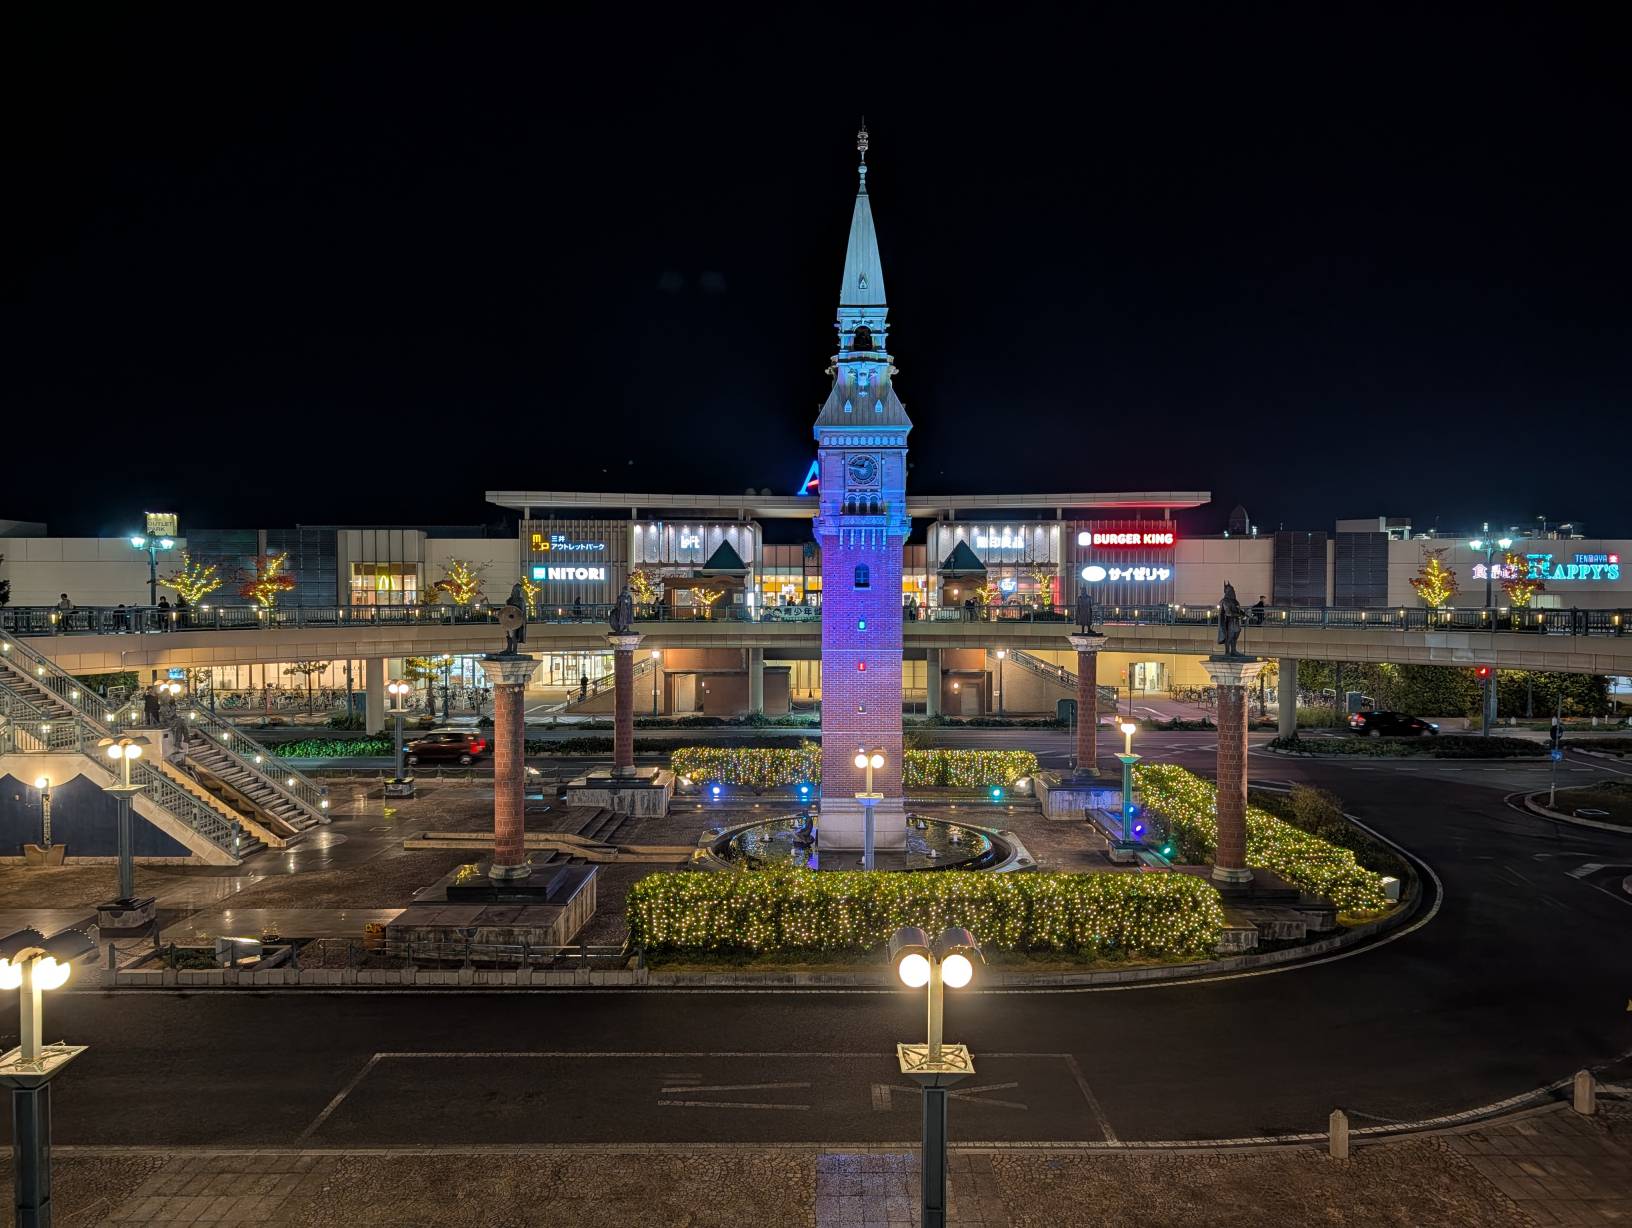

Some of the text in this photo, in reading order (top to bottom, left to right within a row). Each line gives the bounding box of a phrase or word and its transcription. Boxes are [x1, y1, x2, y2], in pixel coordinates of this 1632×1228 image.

[551, 535, 566, 543] 三井
[1093, 533, 1142, 545] BURGER
[1143, 533, 1174, 545] KING
[551, 543, 605, 551] アウトレットパーク
[1526, 554, 1620, 580] HAPPY'S
[548, 567, 605, 580] NITORI
[1108, 567, 1170, 581] サイゼリヤ
